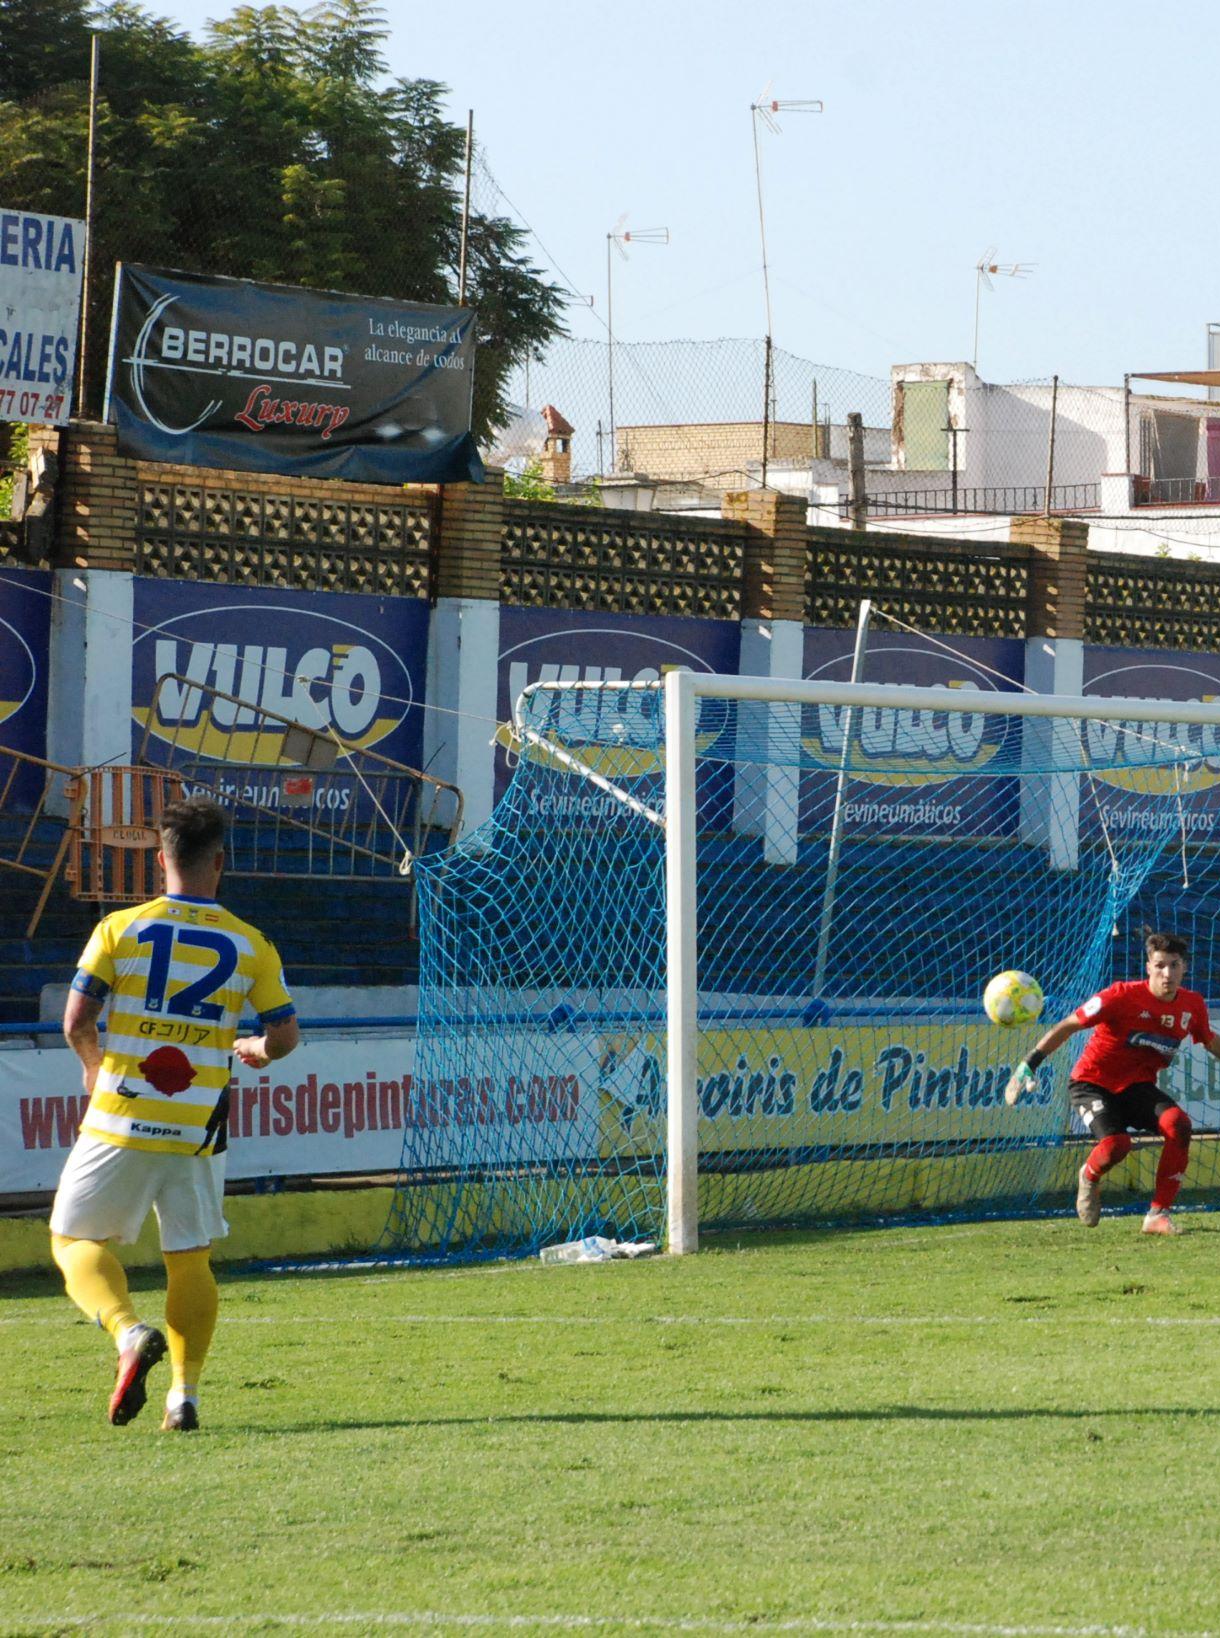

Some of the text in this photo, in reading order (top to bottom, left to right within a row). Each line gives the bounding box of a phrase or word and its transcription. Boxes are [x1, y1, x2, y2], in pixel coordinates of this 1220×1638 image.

[369, 318, 462, 344] La elegancia al
[161, 326, 344, 378] BERROCAR
[364, 344, 465, 370] alcance de todos
[20, 392, 40, 417] 07
[234, 384, 350, 440] Luxury
[155, 639, 382, 735] VULCO
[509, 661, 702, 742] VULC
[843, 799, 962, 825] evineumáticos
[137, 923, 238, 1022] 12
[1160, 1014, 1175, 1028] 13
[809, 1043, 864, 1113] de
[876, 1045, 1054, 1112] Pinturs
[130, 1122, 182, 1137] Kappa
